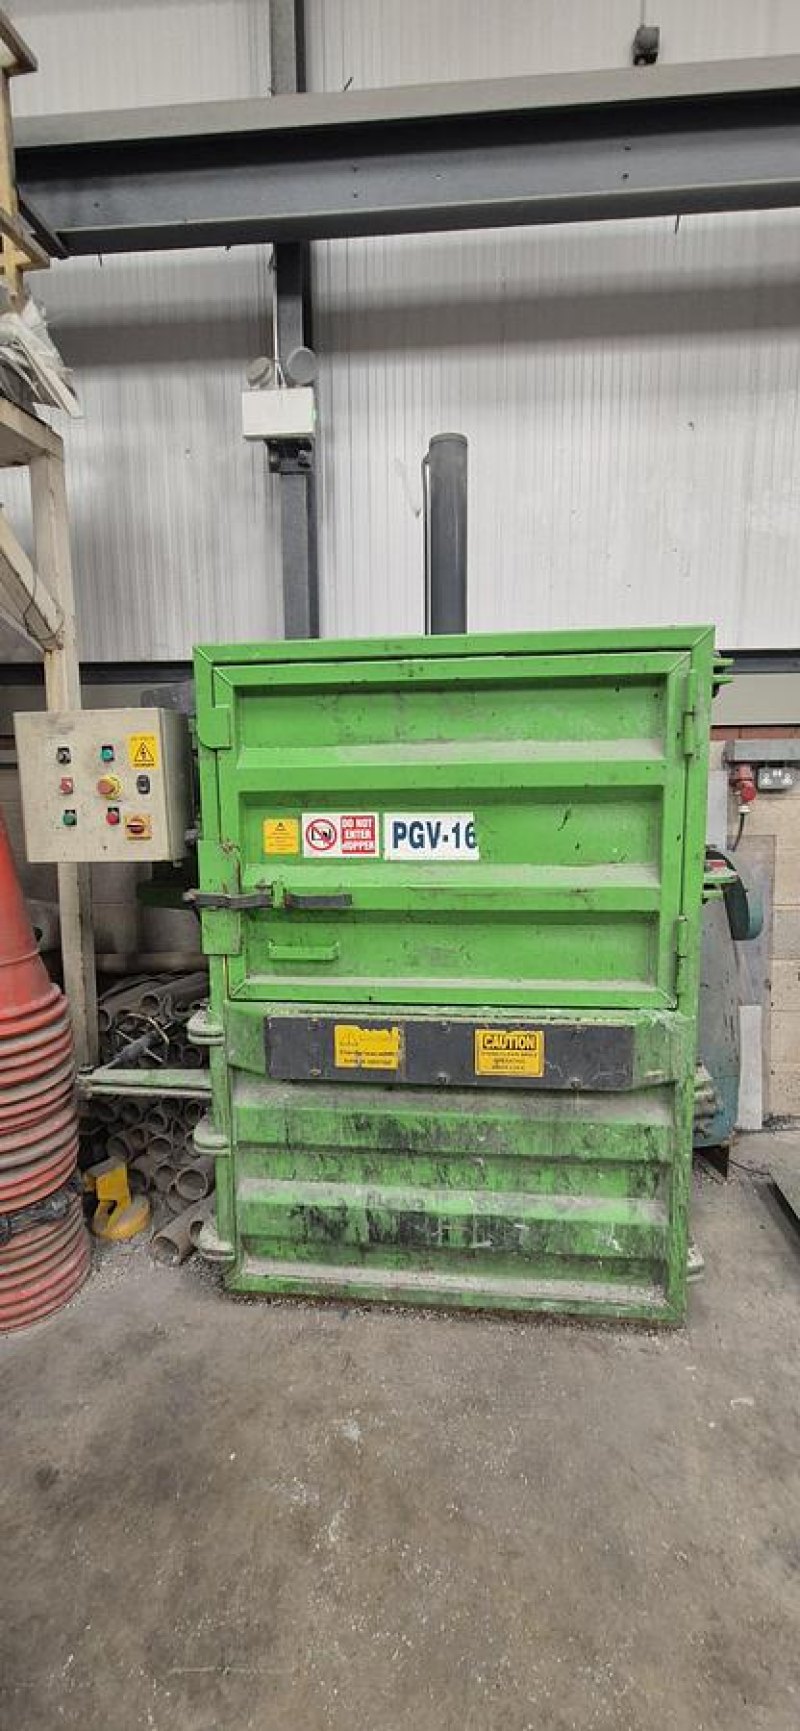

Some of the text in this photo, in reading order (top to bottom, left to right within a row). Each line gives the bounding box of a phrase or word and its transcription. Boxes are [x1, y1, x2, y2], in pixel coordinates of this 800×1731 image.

[342, 818, 372, 828] DO NOT
[345, 829, 372, 839] ENTER
[483, 1035, 536, 1049] CAUTION
